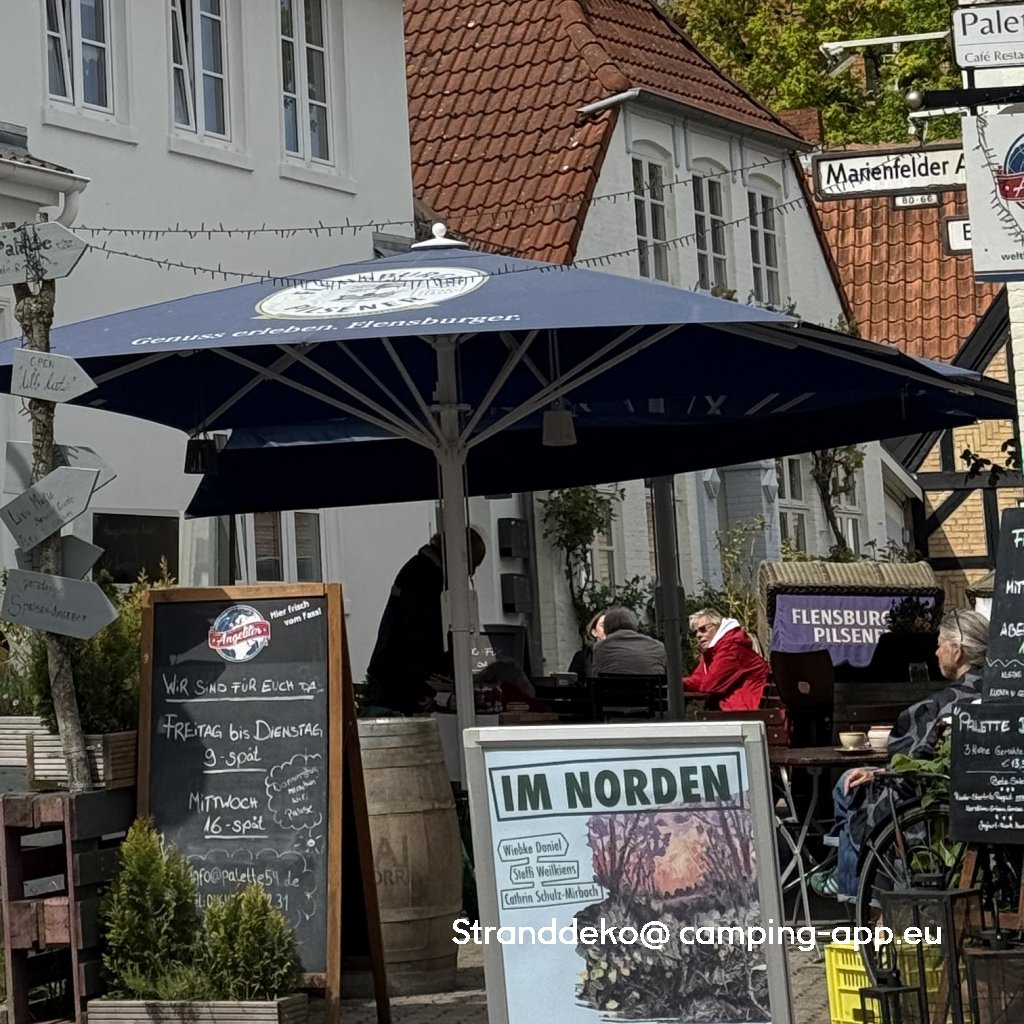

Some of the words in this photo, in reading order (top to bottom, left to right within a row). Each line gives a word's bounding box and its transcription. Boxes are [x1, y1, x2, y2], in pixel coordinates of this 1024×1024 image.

[965, 50, 991, 63] Café
[827, 156, 949, 184] Marienfelder
[284, 297, 426, 314] PILSENER
[131, 331, 226, 346] Genuss
[232, 323, 338, 338] erleben.
[345, 313, 521, 330] Flensburger.
[270, 609, 286, 620] Hier
[288, 600, 310, 614] frisch
[283, 615, 302, 627] vom
[261, 679, 294, 692] EUCH
[229, 723, 251, 741] bis
[501, 774, 553, 811] IM
[564, 764, 732, 809] NORDEN
[503, 842, 533, 857] Wiebke
[513, 867, 535, 880] Steffi
[504, 893, 534, 906] Cathrin
[536, 884, 599, 903] Schulz-Mirbach
